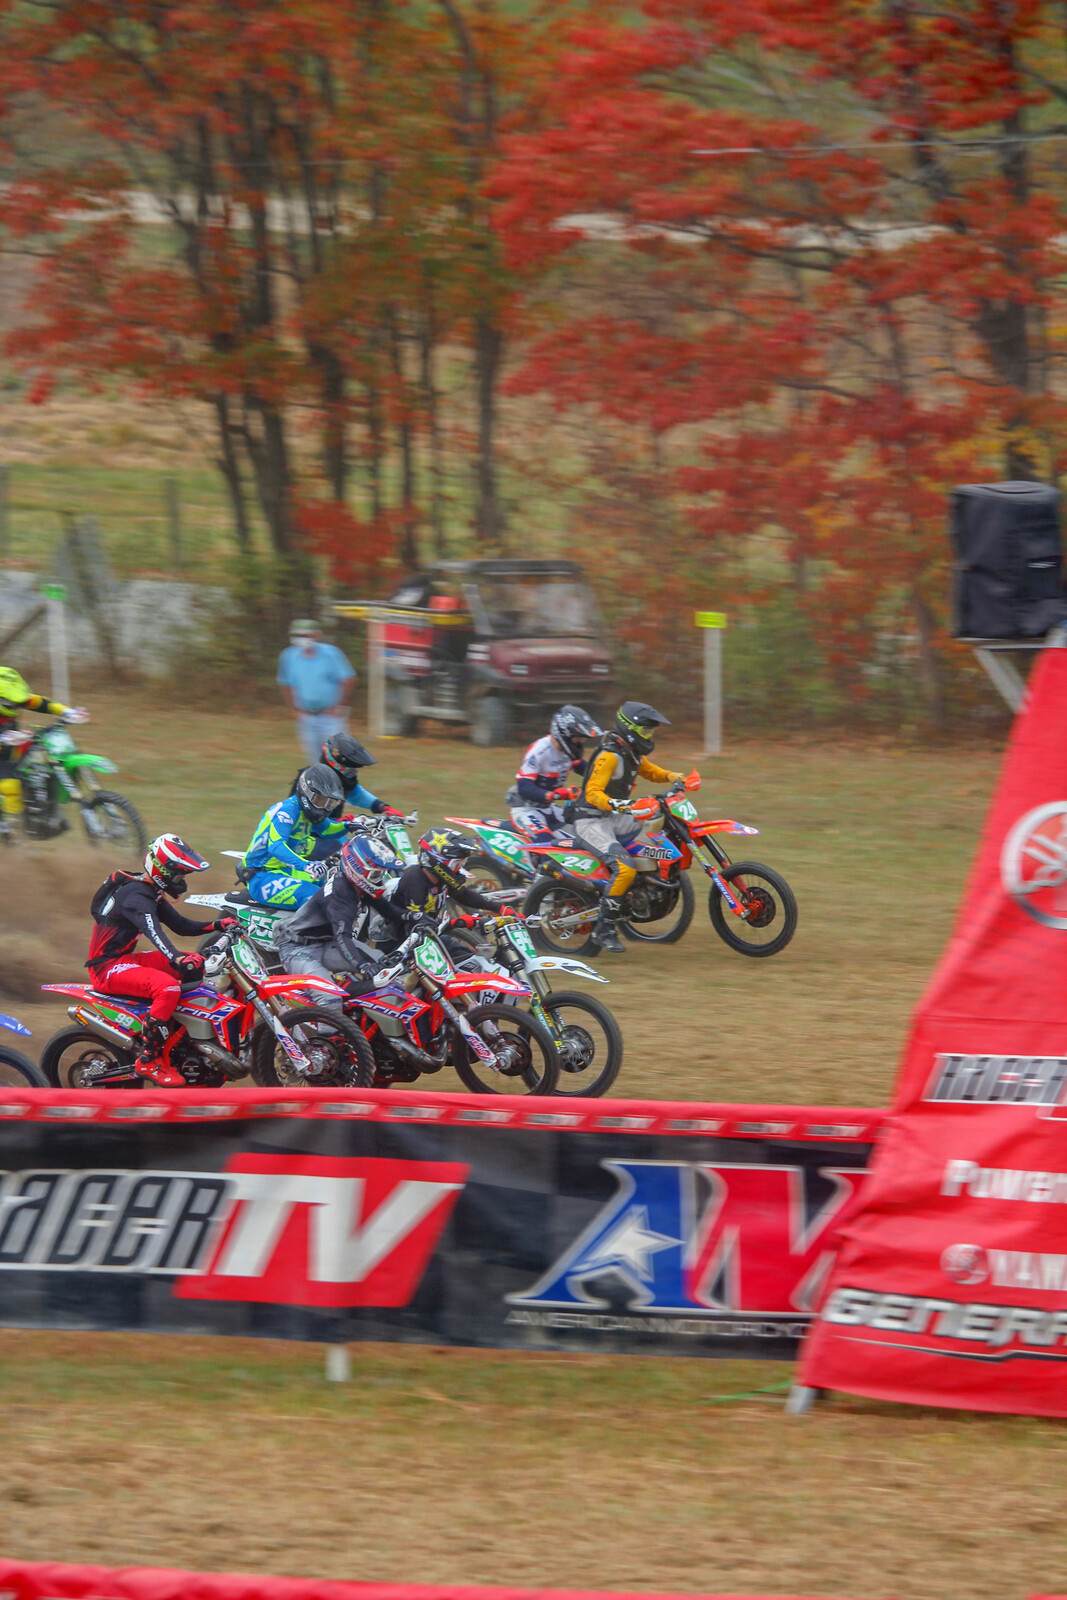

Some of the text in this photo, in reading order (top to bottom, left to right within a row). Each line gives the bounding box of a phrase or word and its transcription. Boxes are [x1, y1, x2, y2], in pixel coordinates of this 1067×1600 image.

[678, 801, 698, 821] 24
[561, 856, 594, 870] 24
[713, 877, 735, 905] DUNLOP
[114, 1013, 135, 1028] 99
